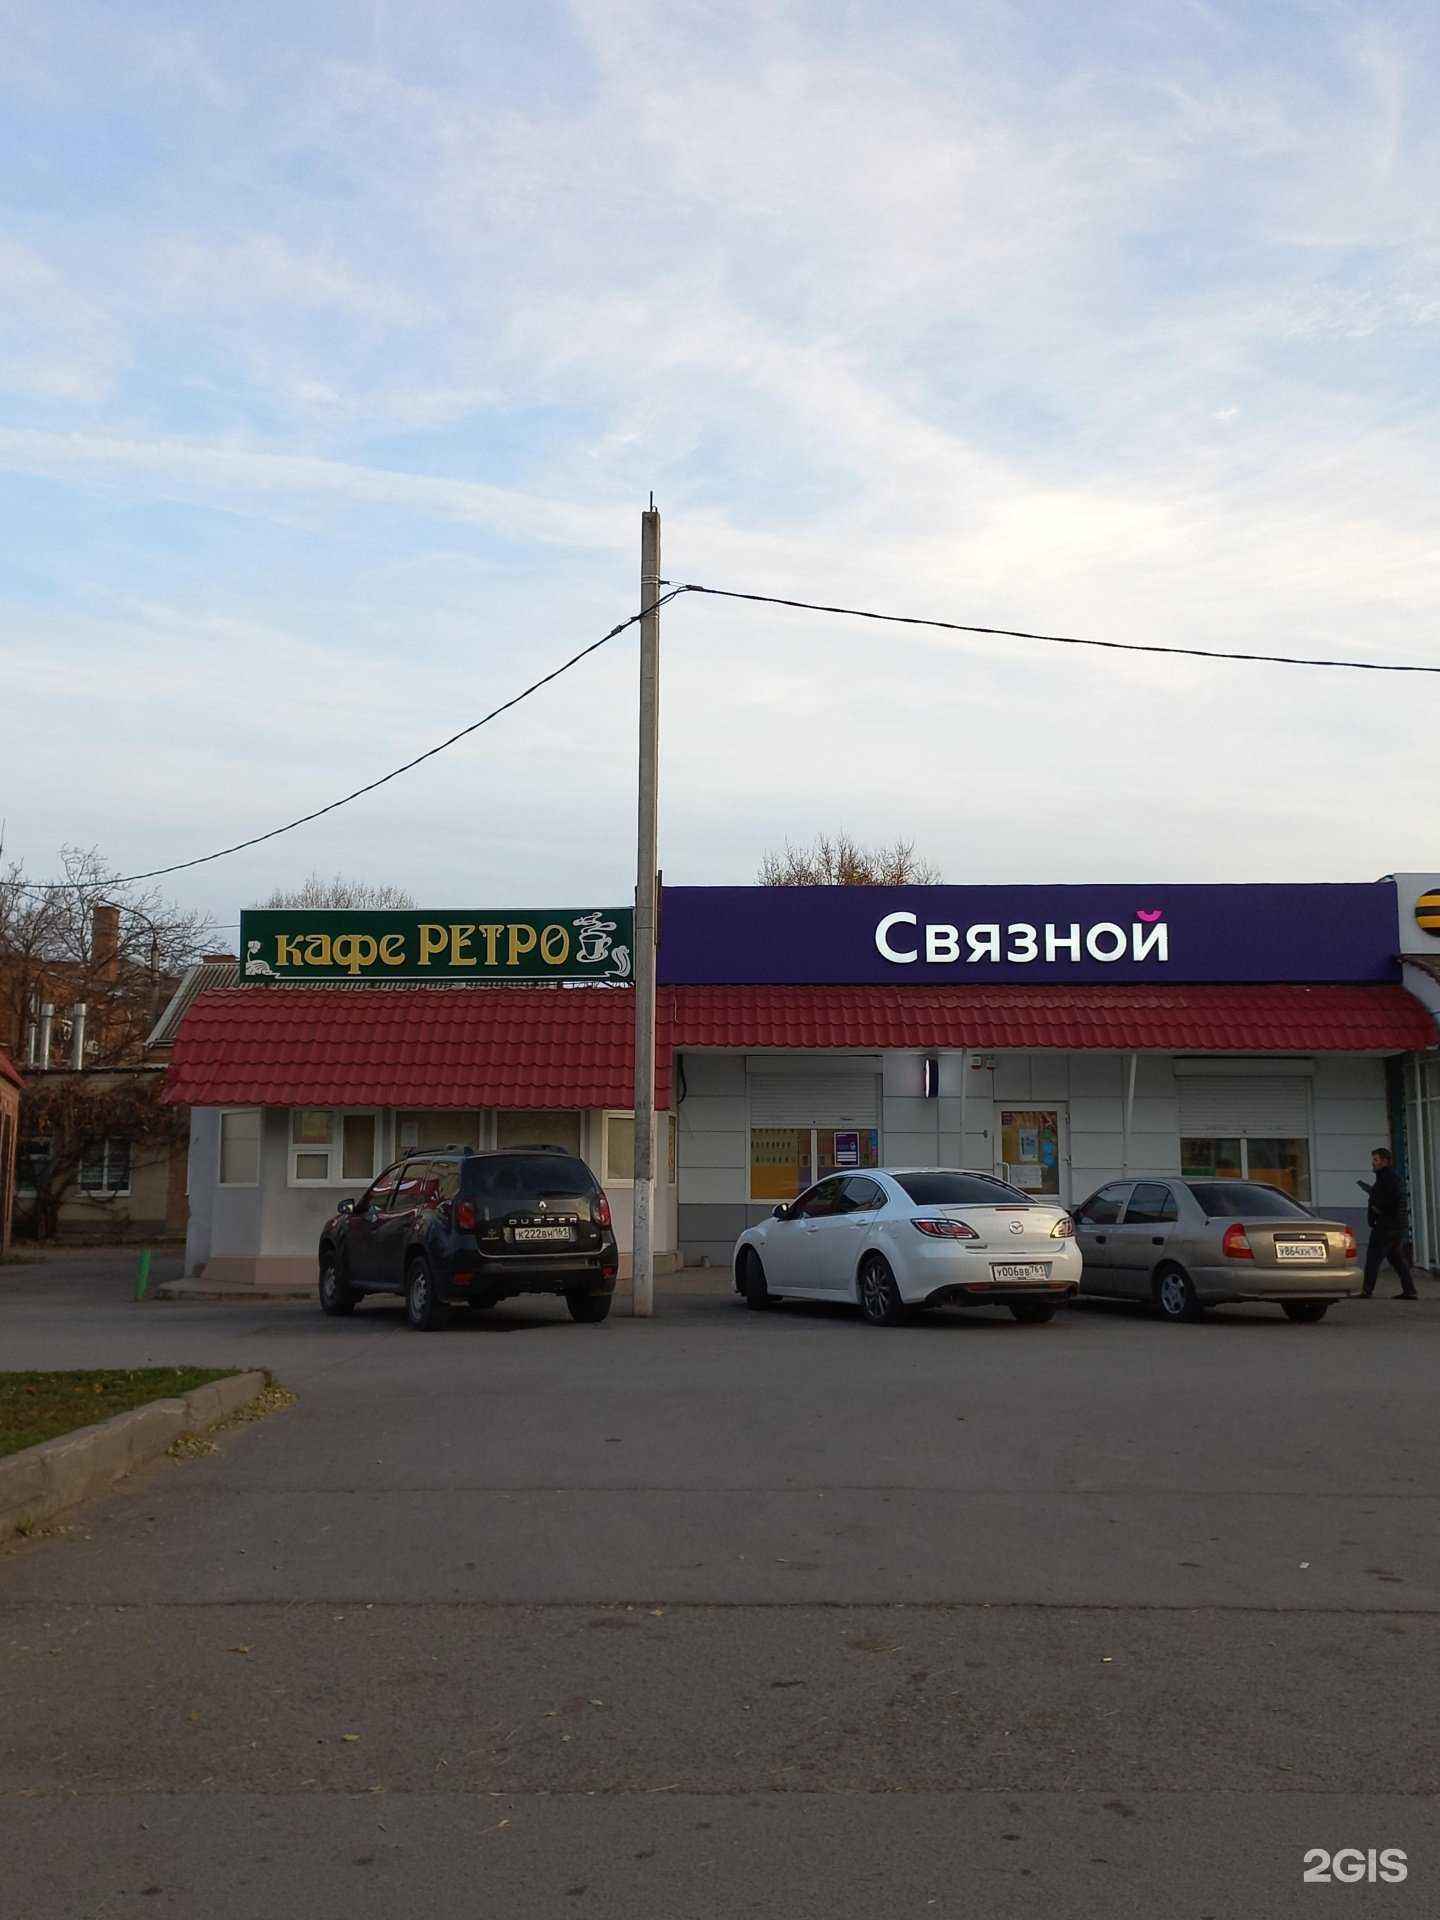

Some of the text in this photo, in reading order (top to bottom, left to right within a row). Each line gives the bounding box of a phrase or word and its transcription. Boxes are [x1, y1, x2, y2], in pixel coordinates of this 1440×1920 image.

[274, 924, 570, 975] кафе РЕТРО
[875, 910, 1169, 964] Связной
